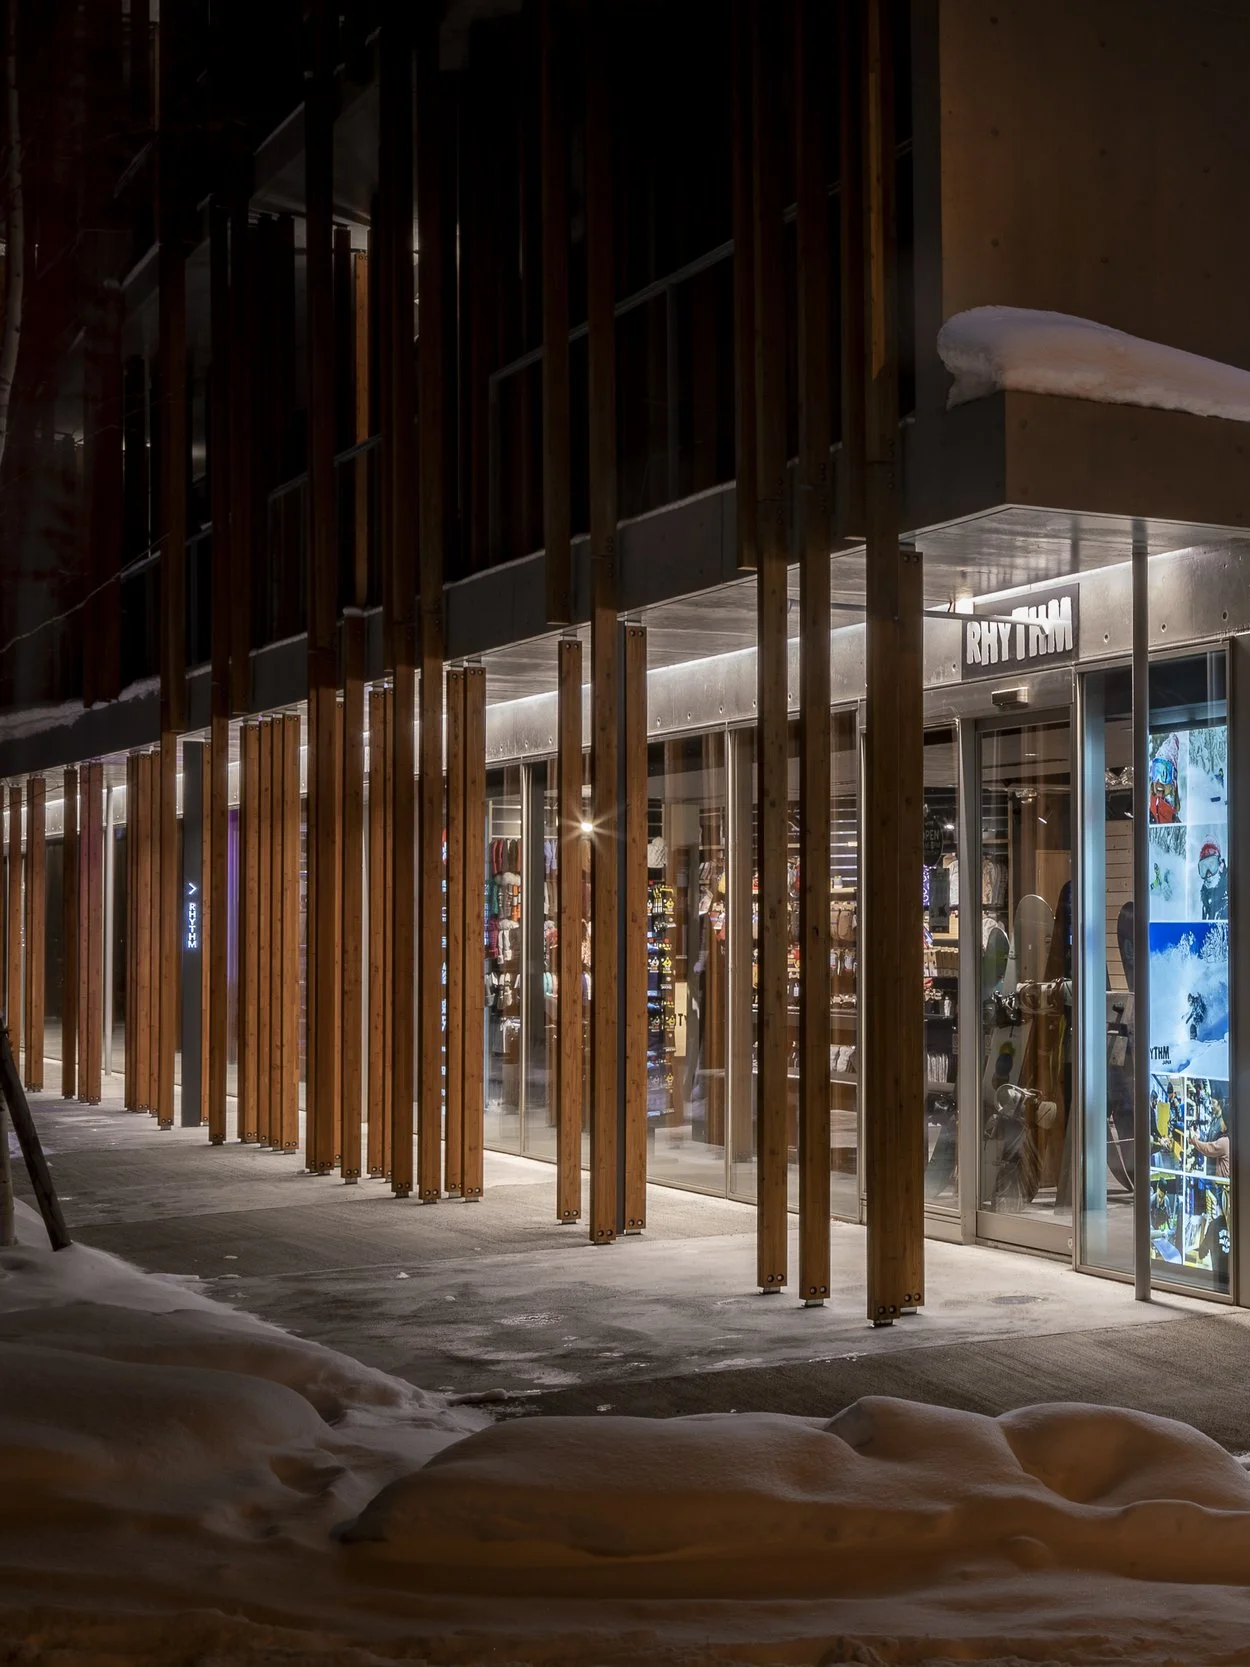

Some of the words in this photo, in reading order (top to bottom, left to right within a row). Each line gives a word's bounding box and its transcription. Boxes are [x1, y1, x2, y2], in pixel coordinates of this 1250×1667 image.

[966, 596, 1073, 666] RHYTHM
[187, 902, 198, 949] RHYTHM
[1149, 1045, 1170, 1060] YTHM
